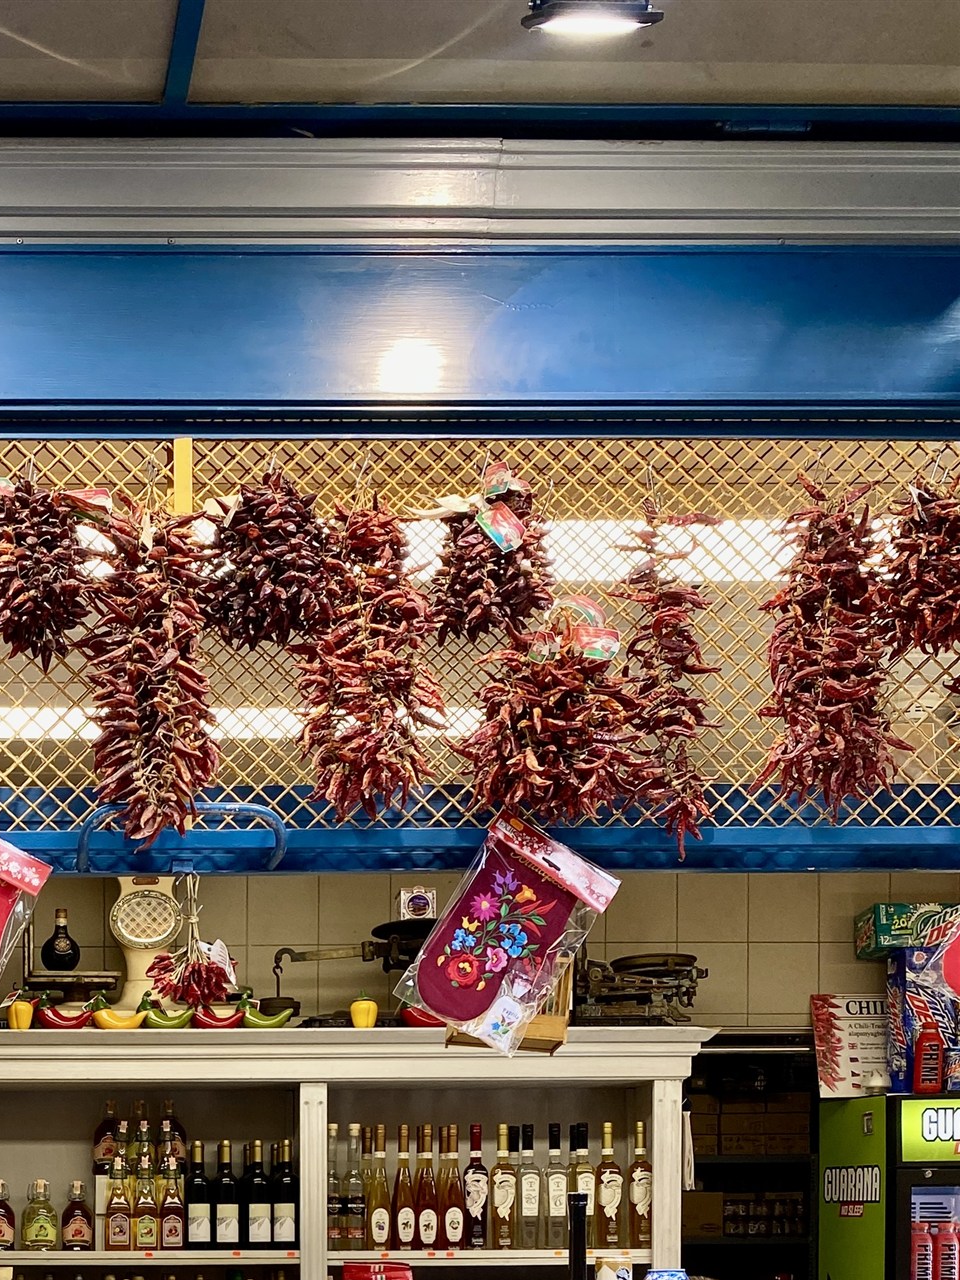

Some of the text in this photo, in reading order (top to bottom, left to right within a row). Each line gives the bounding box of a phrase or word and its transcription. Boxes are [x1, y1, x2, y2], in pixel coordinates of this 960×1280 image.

[921, 1043, 938, 1087] PRIME
[823, 1166, 881, 1203] GUARANA
[848, 1203, 864, 1216] SLEEP
